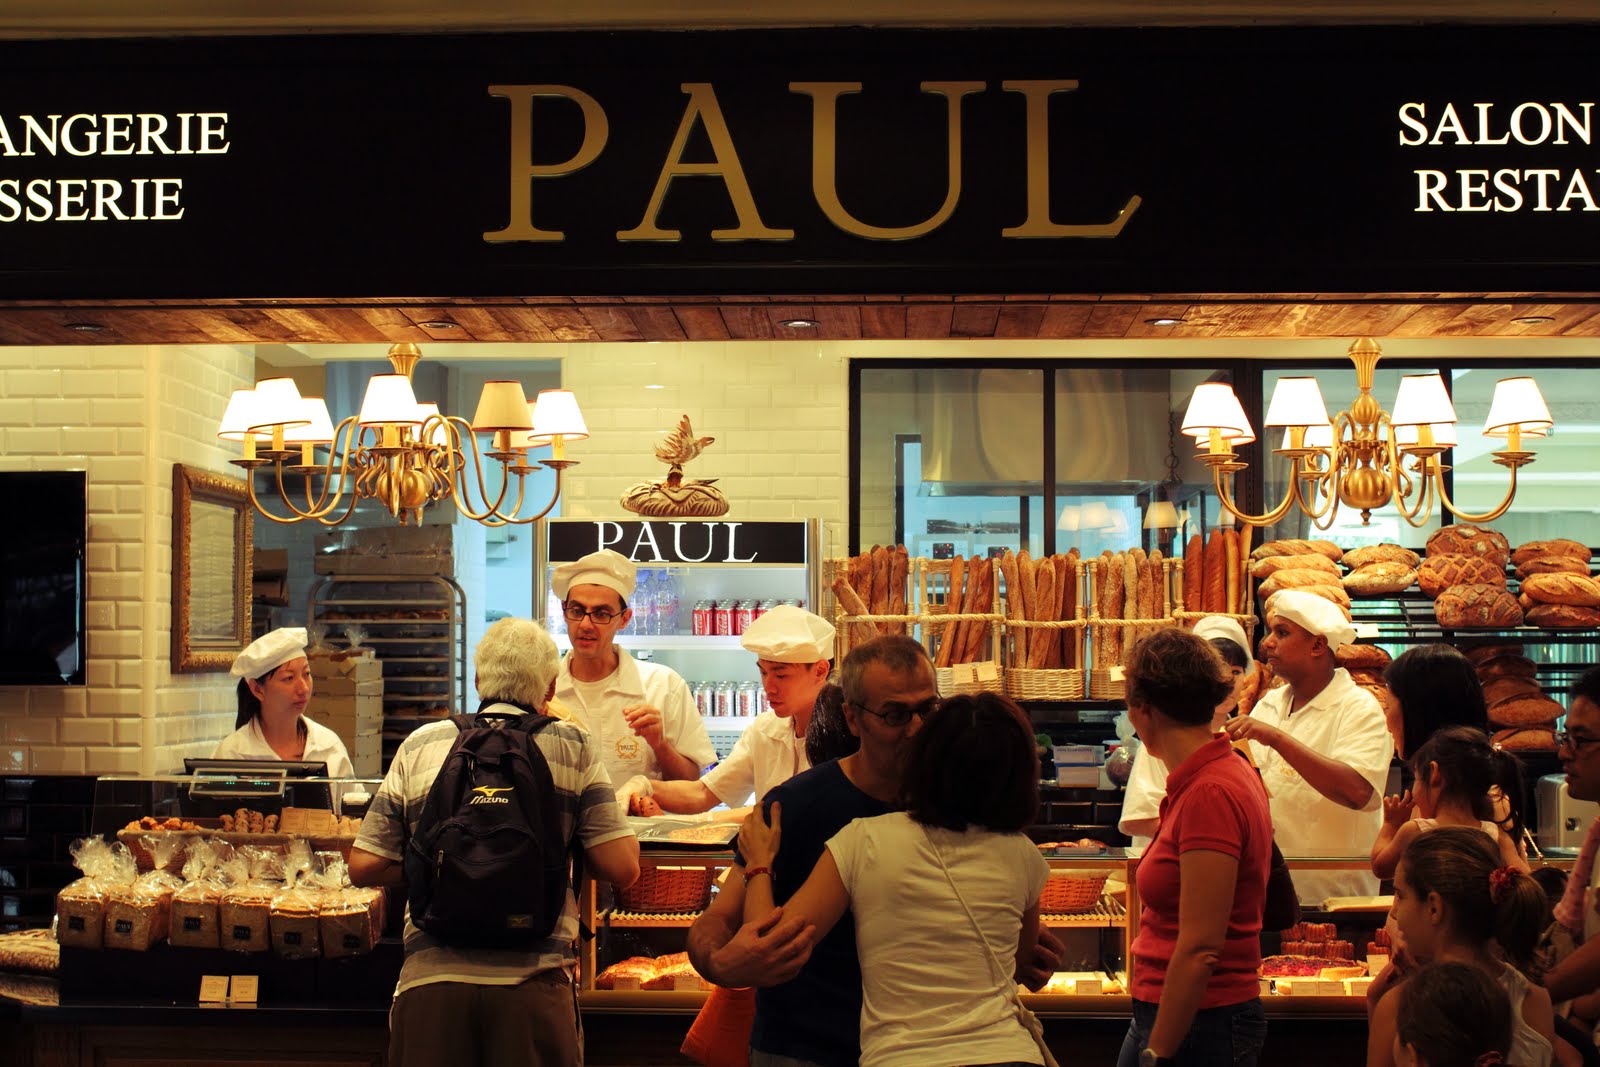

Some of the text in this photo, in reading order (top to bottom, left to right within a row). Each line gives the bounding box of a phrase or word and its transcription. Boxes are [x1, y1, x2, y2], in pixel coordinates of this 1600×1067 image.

[0, 113, 231, 156] ANGERIE
[1398, 102, 1595, 146] SALON
[483, 80, 1142, 242] PAUL
[0, 178, 185, 222] SSERIE
[1413, 168, 1600, 212] RESTA
[593, 521, 758, 563] PAUL
